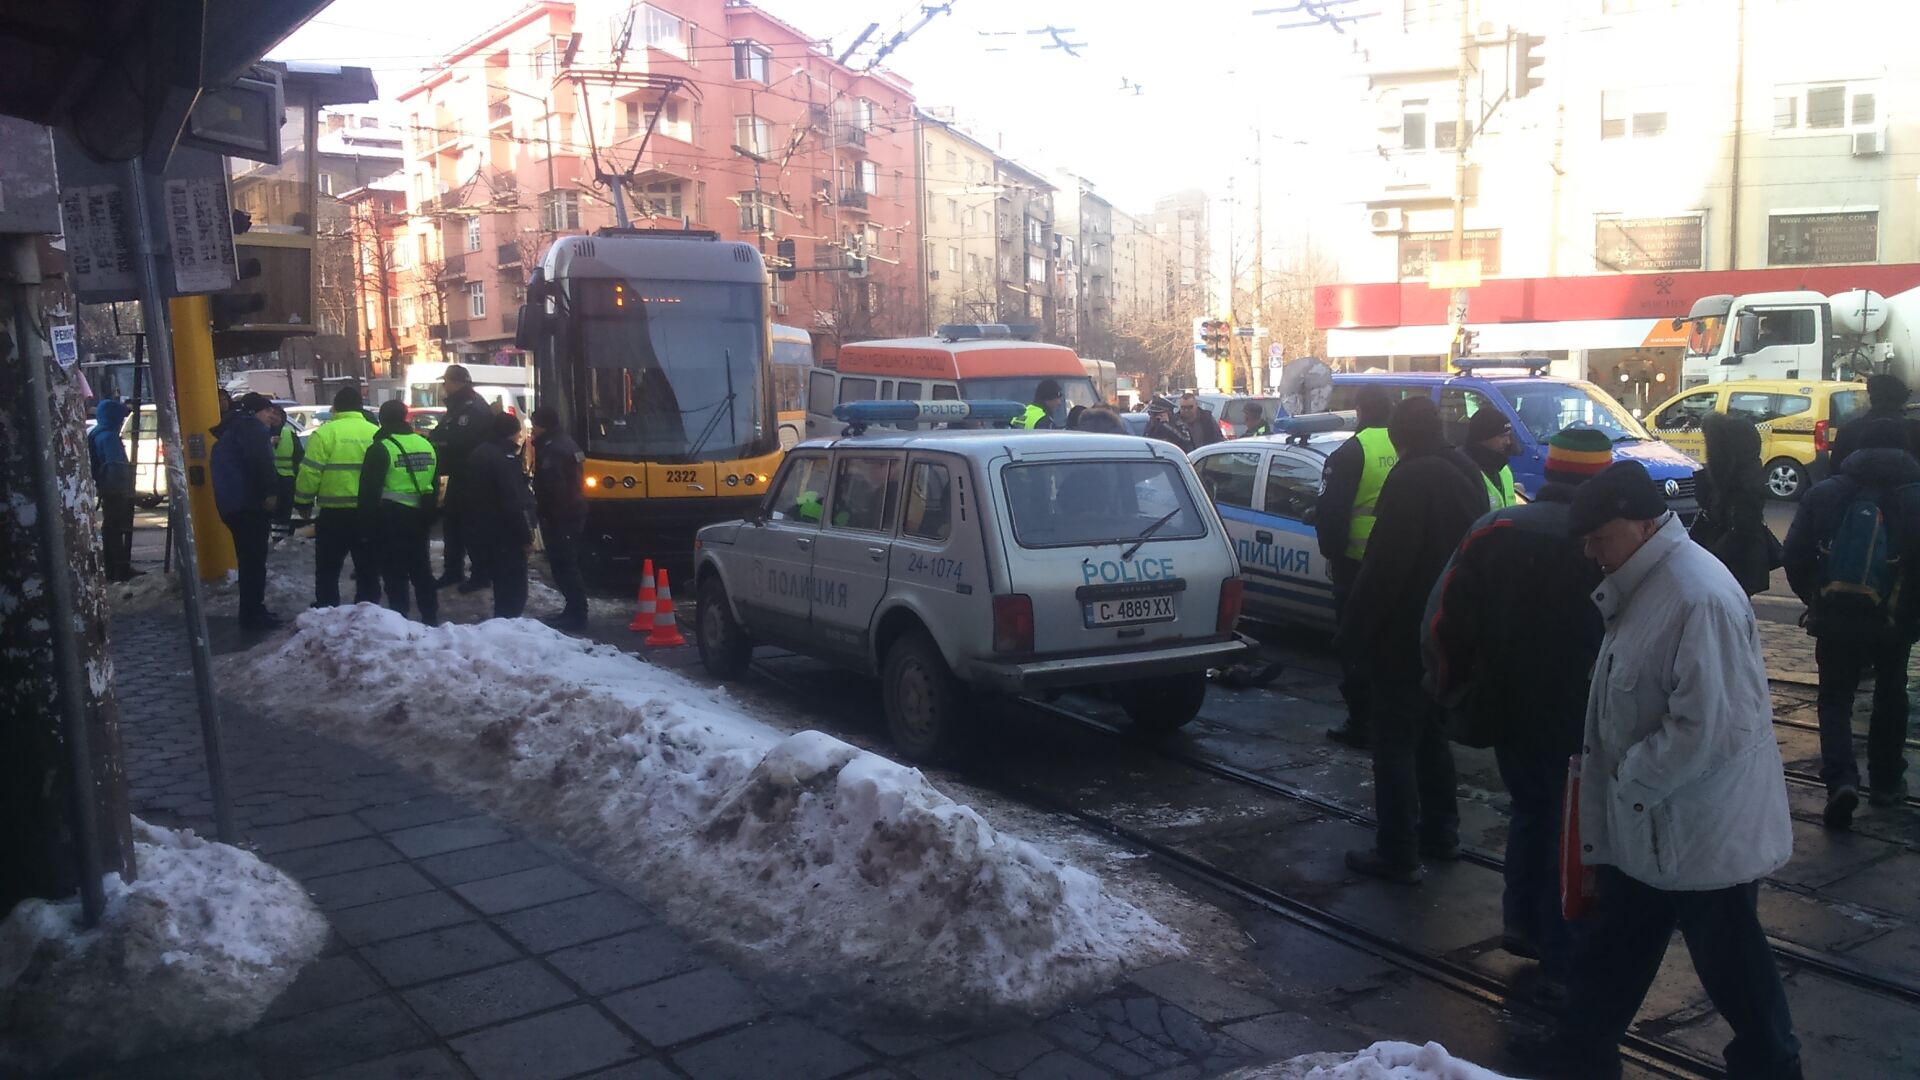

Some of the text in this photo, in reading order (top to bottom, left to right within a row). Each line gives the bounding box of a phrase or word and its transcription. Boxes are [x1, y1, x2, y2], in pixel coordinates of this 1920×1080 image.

[922, 404, 966, 415] POLICE
[1378, 456, 1398, 468] ПО
[666, 470, 697, 483] 2322
[908, 552, 964, 580] 24-1074
[1234, 537, 1310, 575] ЛИЦИЯ
[1081, 557, 1177, 585] POLICE
[767, 568, 849, 609] ПОЛИЦИЯ
[1117, 601, 1151, 619] 4889
[1153, 598, 1172, 617] XX
